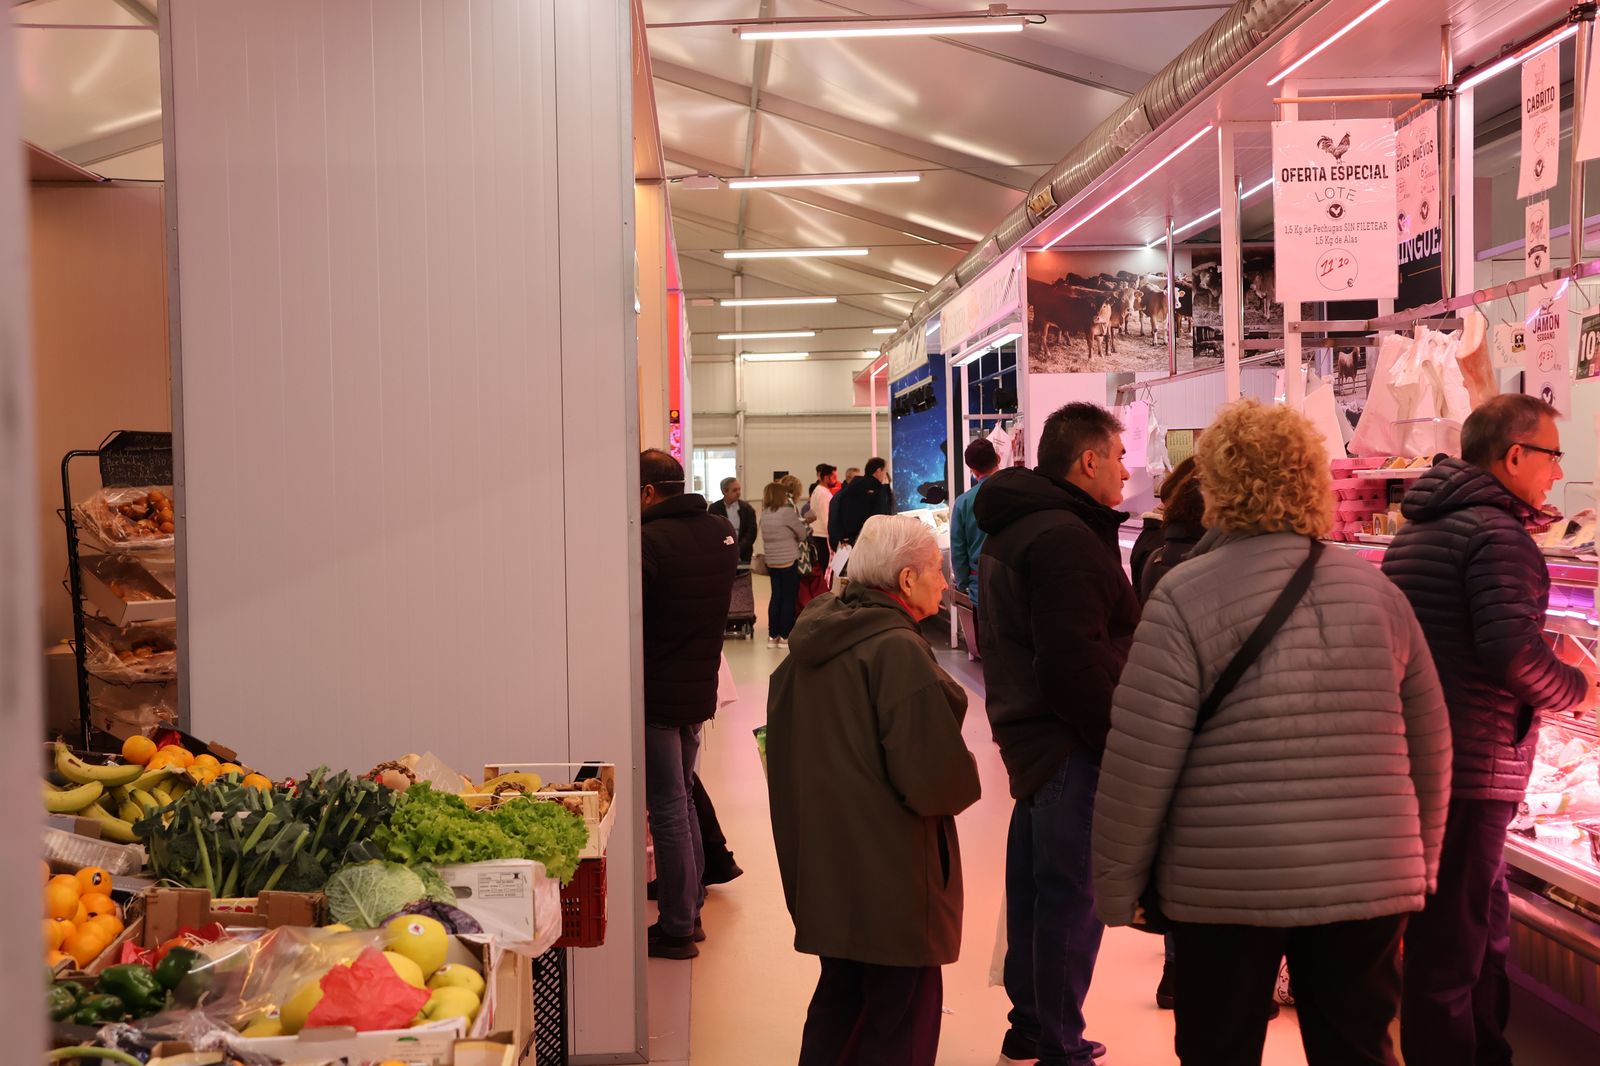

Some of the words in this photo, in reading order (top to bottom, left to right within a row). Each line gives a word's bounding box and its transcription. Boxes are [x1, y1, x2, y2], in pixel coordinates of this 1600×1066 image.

[1526, 86, 1555, 114] CABRITO
[1412, 139, 1434, 164] HUEVOS
[1281, 167, 1327, 183] OFERTA
[1331, 164, 1389, 181] ESPECIAL
[1314, 186, 1358, 203] LOTE
[1294, 224, 1303, 236] Kg
[1304, 224, 1312, 234] de
[1313, 223, 1343, 235] Pechugas
[1344, 222, 1355, 232] SIN
[1356, 221, 1388, 231] FILETEAR
[1324, 235, 1333, 246] Kg
[1334, 235, 1342, 244] de
[1343, 235, 1358, 244] Alas
[1397, 227, 1441, 266] INGUE
